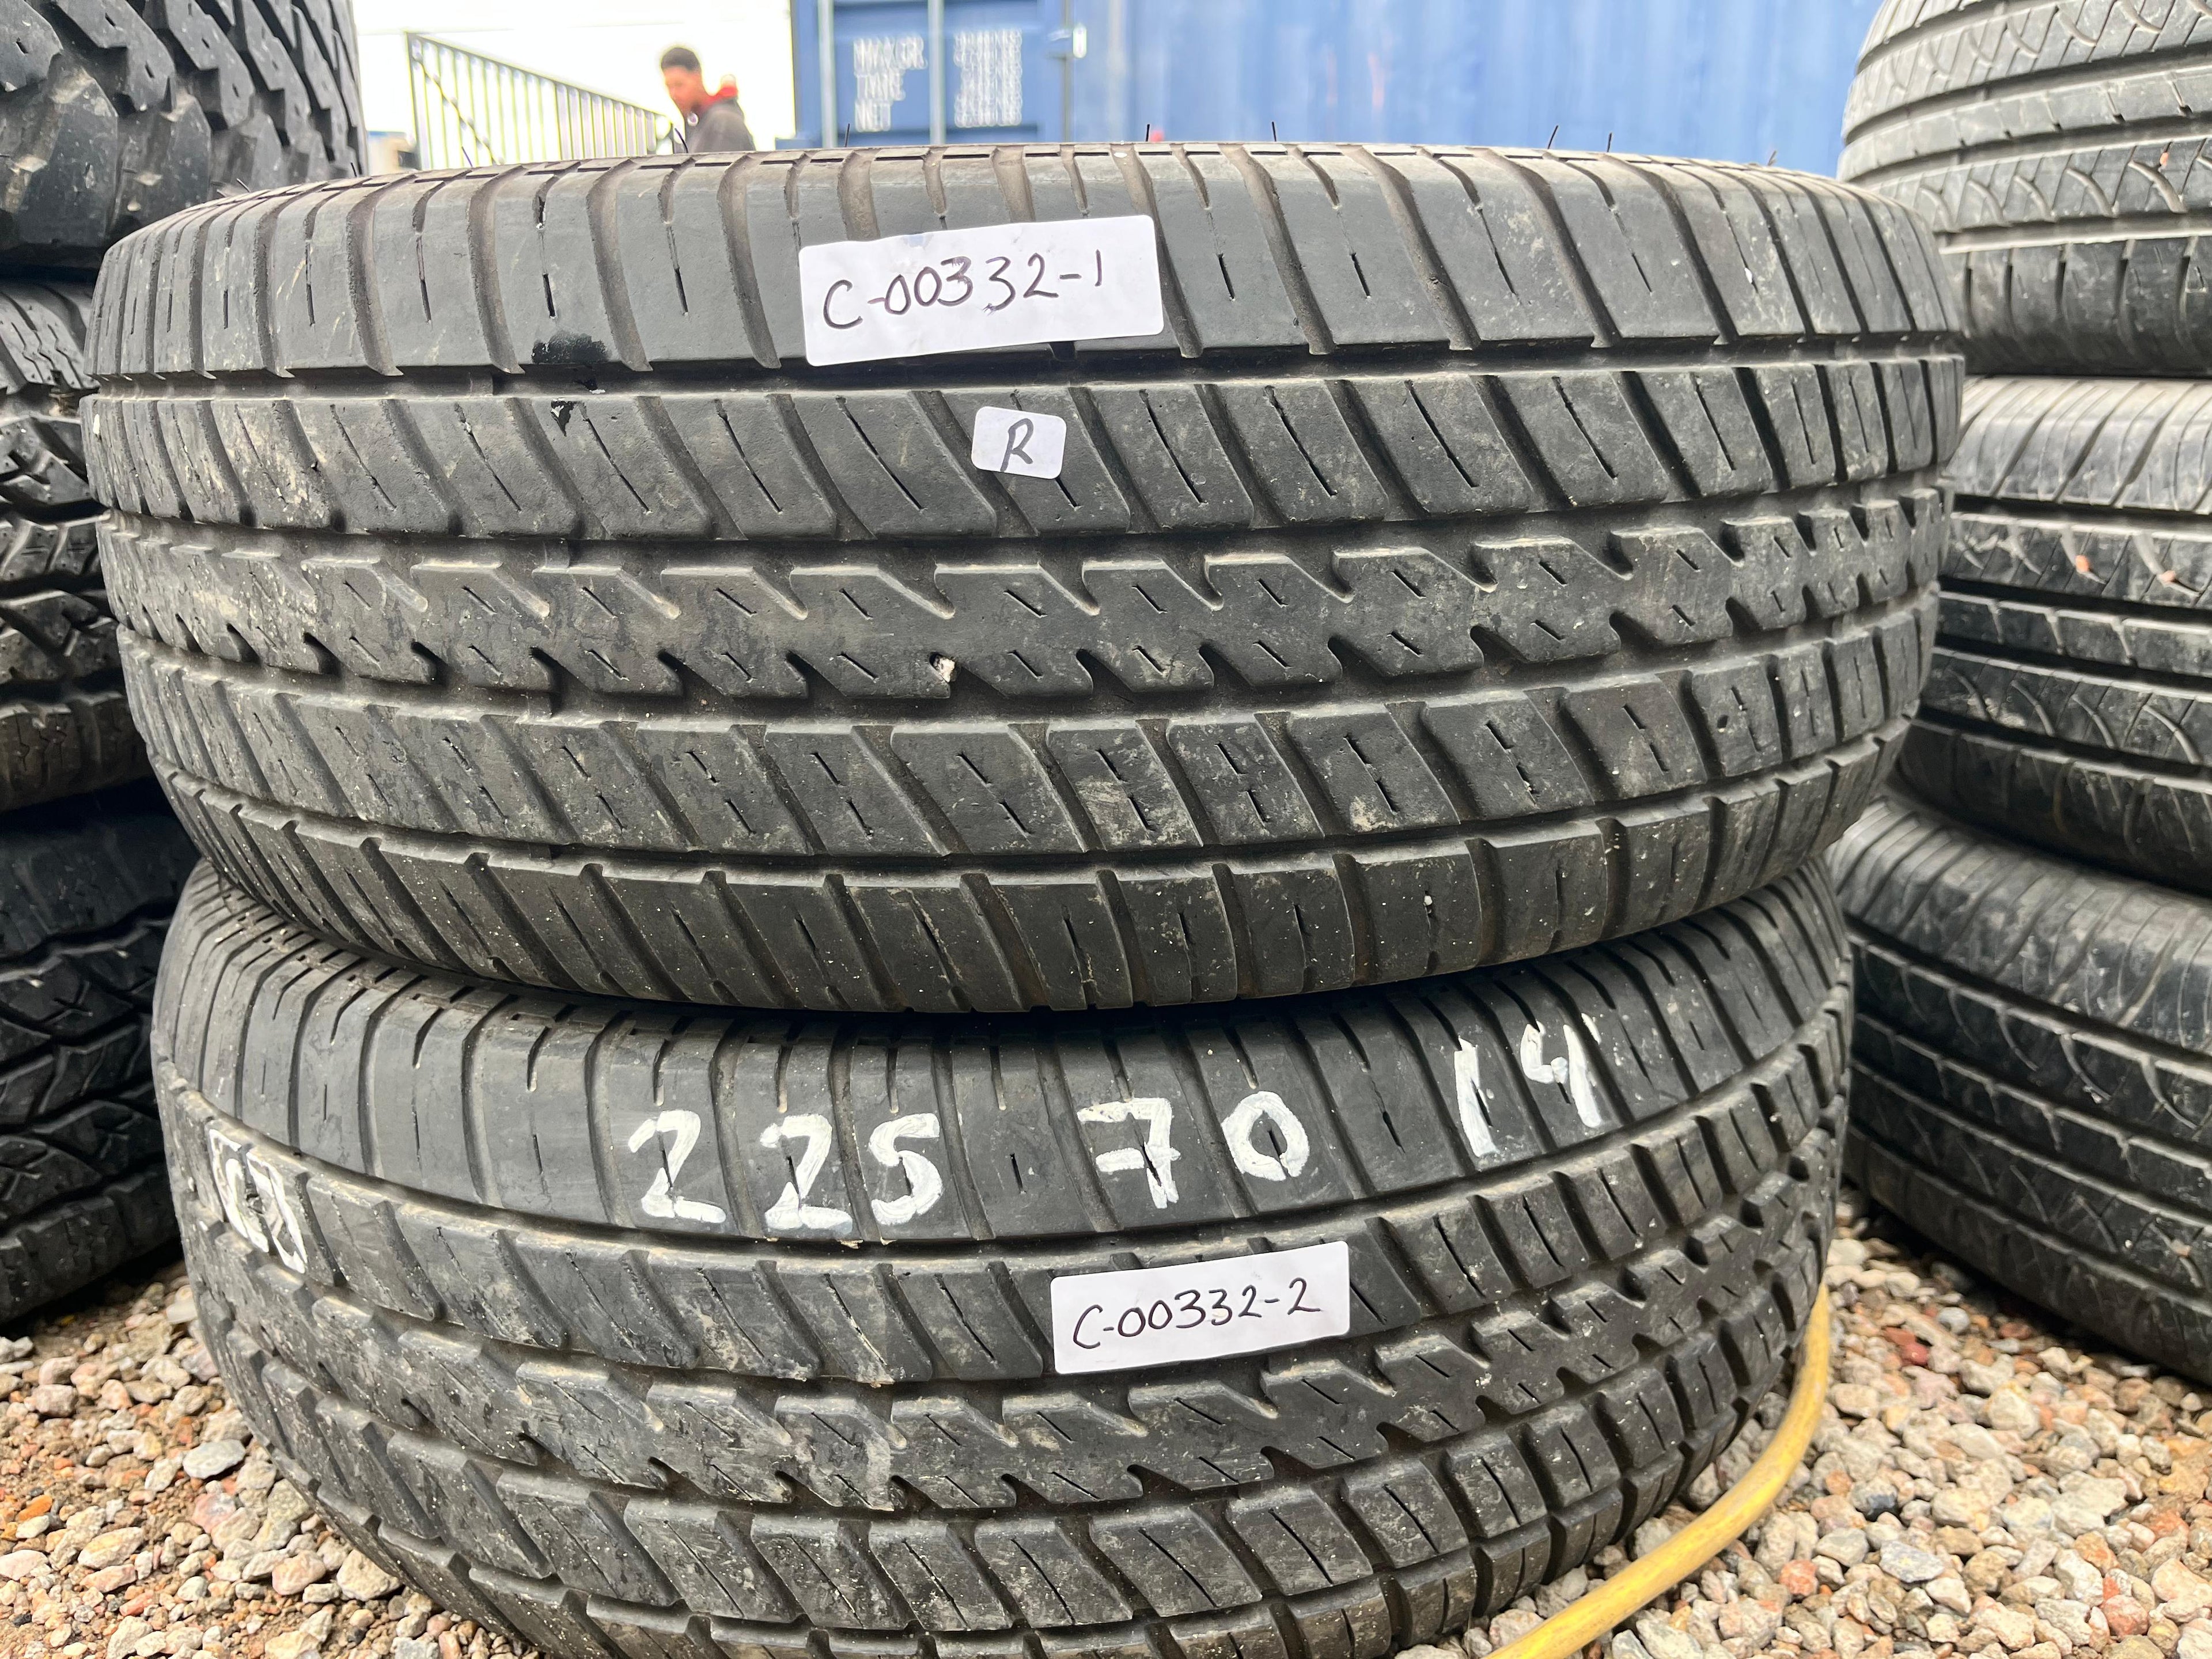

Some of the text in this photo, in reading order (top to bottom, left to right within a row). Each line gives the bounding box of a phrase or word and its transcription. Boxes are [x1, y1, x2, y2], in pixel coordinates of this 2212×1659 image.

[823, 249, 1103, 329] C-00332-1
[999, 418, 1035, 472] R
[627, 1014, 1602, 1236] 225 70 14
[1073, 1277, 1321, 1349] C-00332-2
